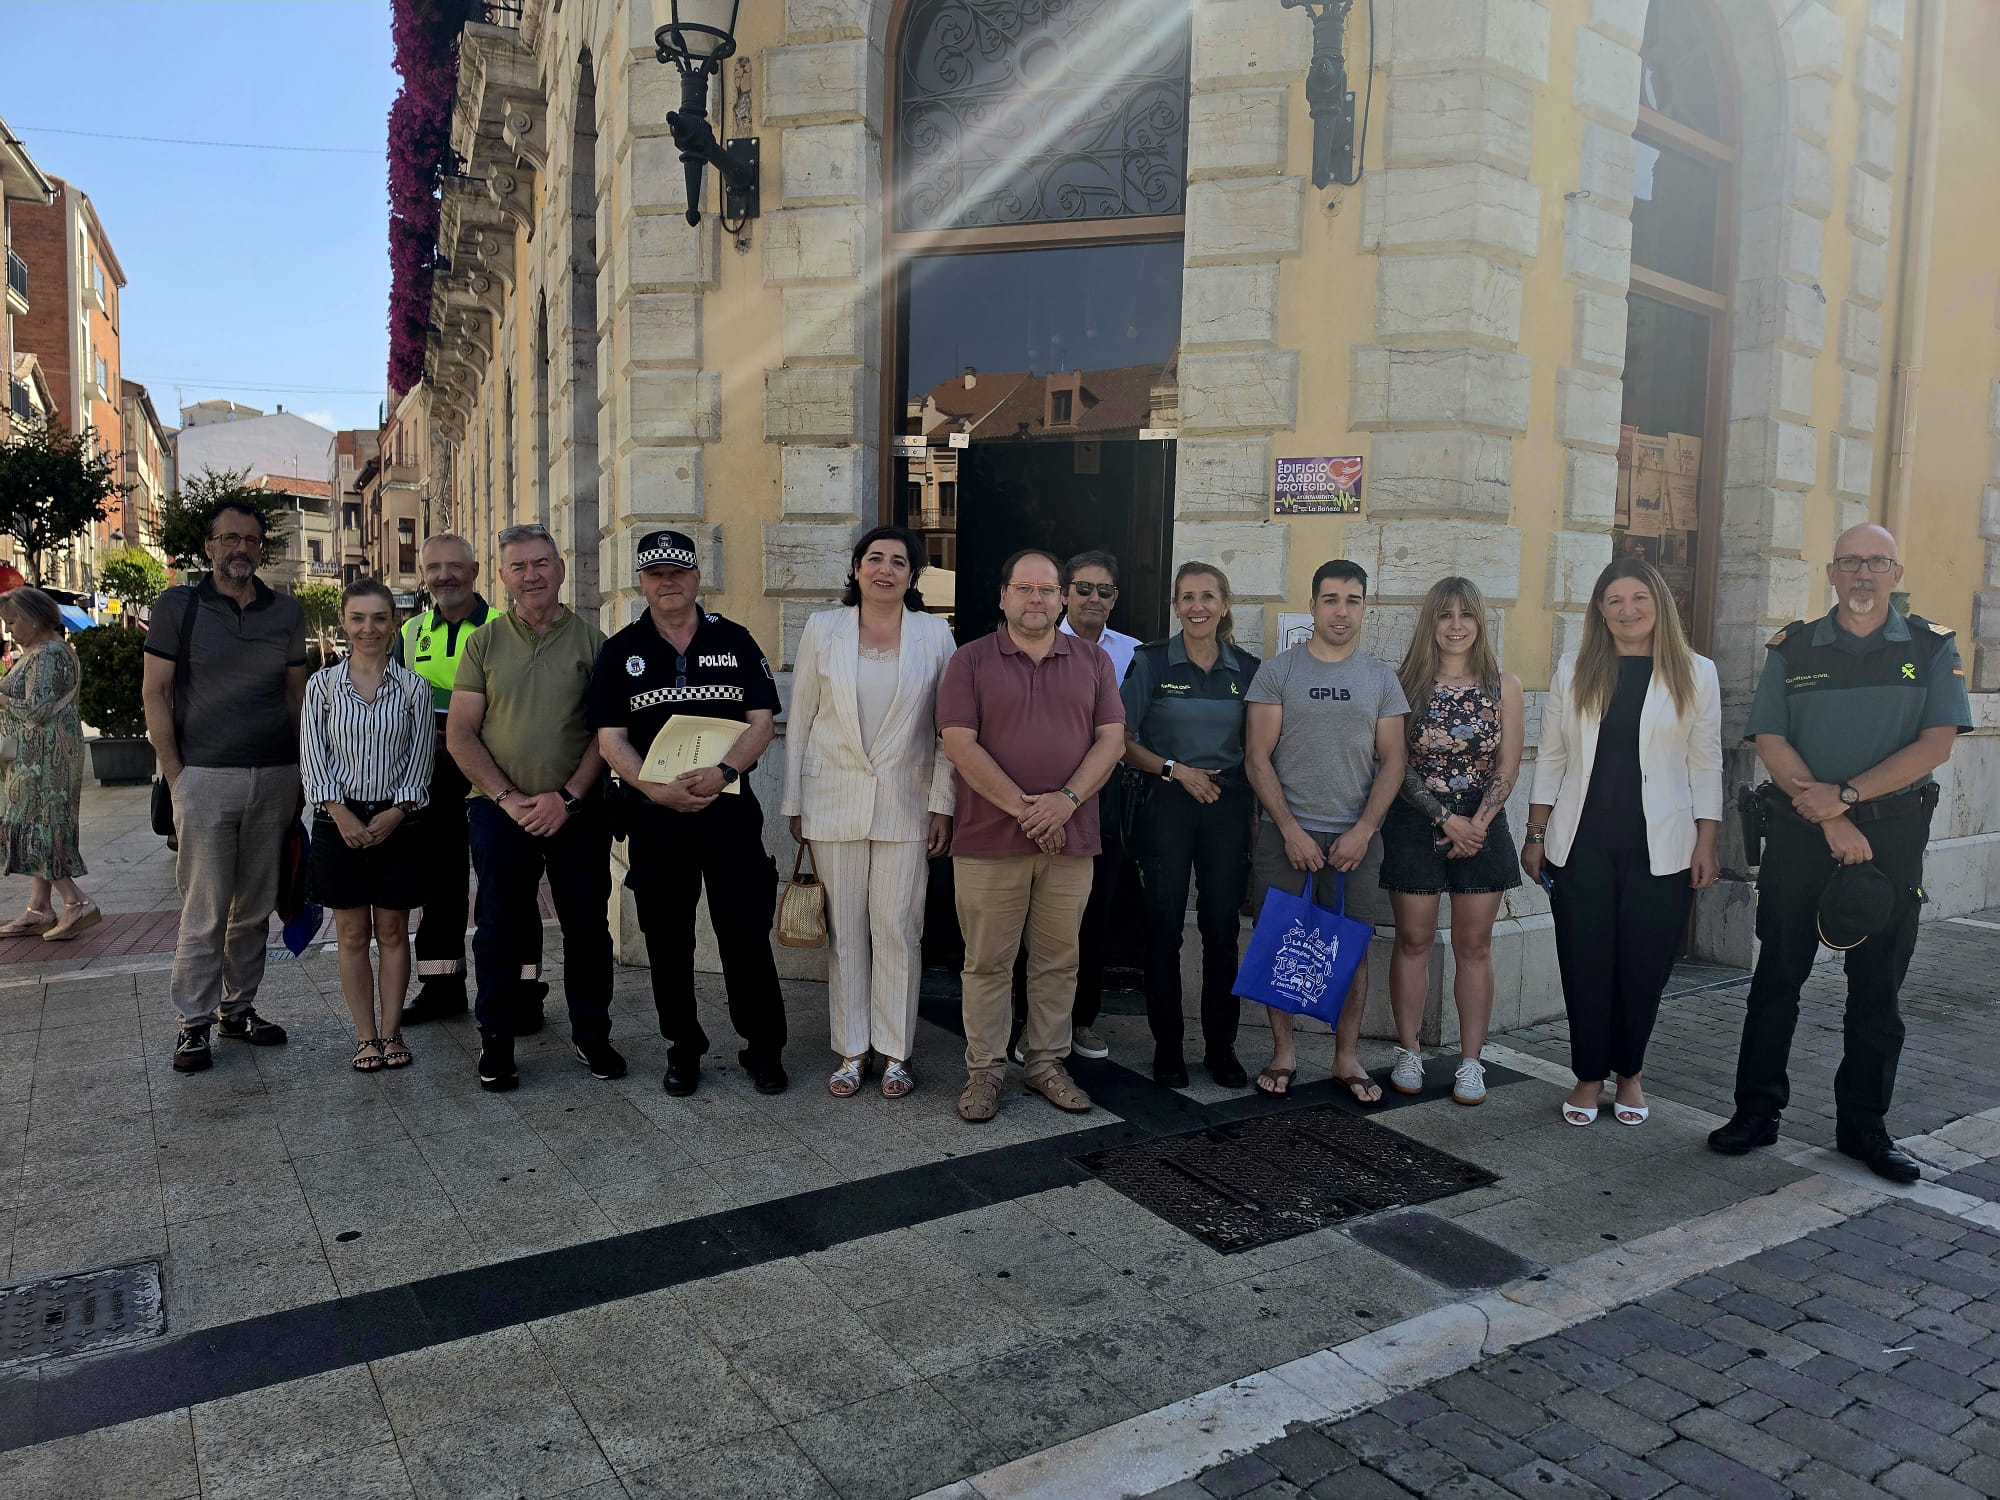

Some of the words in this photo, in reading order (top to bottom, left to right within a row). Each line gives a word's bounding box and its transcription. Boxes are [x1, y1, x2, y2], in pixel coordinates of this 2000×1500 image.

[1277, 463, 1328, 474] EDIFICIO
[1277, 473, 1326, 483] CARDIO
[1277, 483, 1335, 492] PROTEGIDO
[698, 652, 738, 668] POLICÍA
[1309, 687, 1351, 701] GPLB
[1292, 939, 1301, 947] LA
